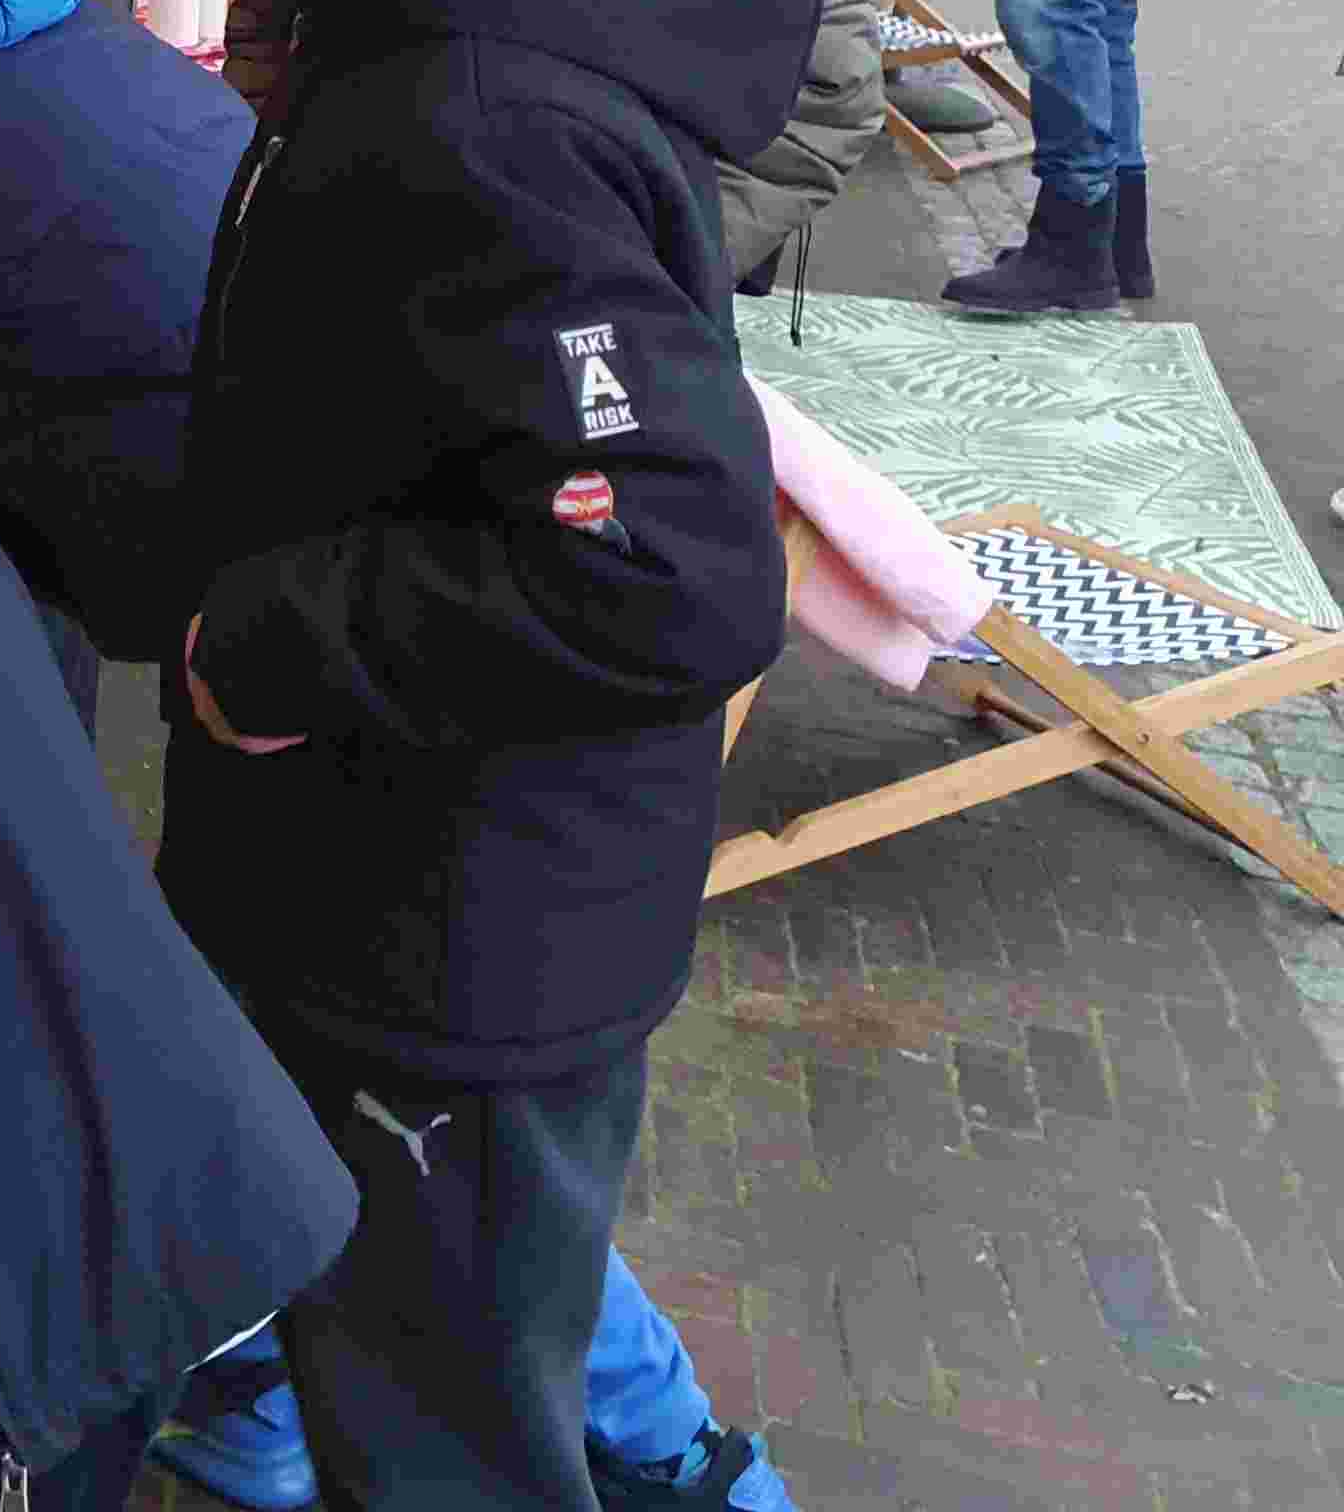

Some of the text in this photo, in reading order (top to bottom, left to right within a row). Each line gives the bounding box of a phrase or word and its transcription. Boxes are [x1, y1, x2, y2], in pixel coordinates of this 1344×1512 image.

[563, 331, 617, 359] TAKE
[581, 355, 628, 408] A
[584, 402, 635, 431] RISK
